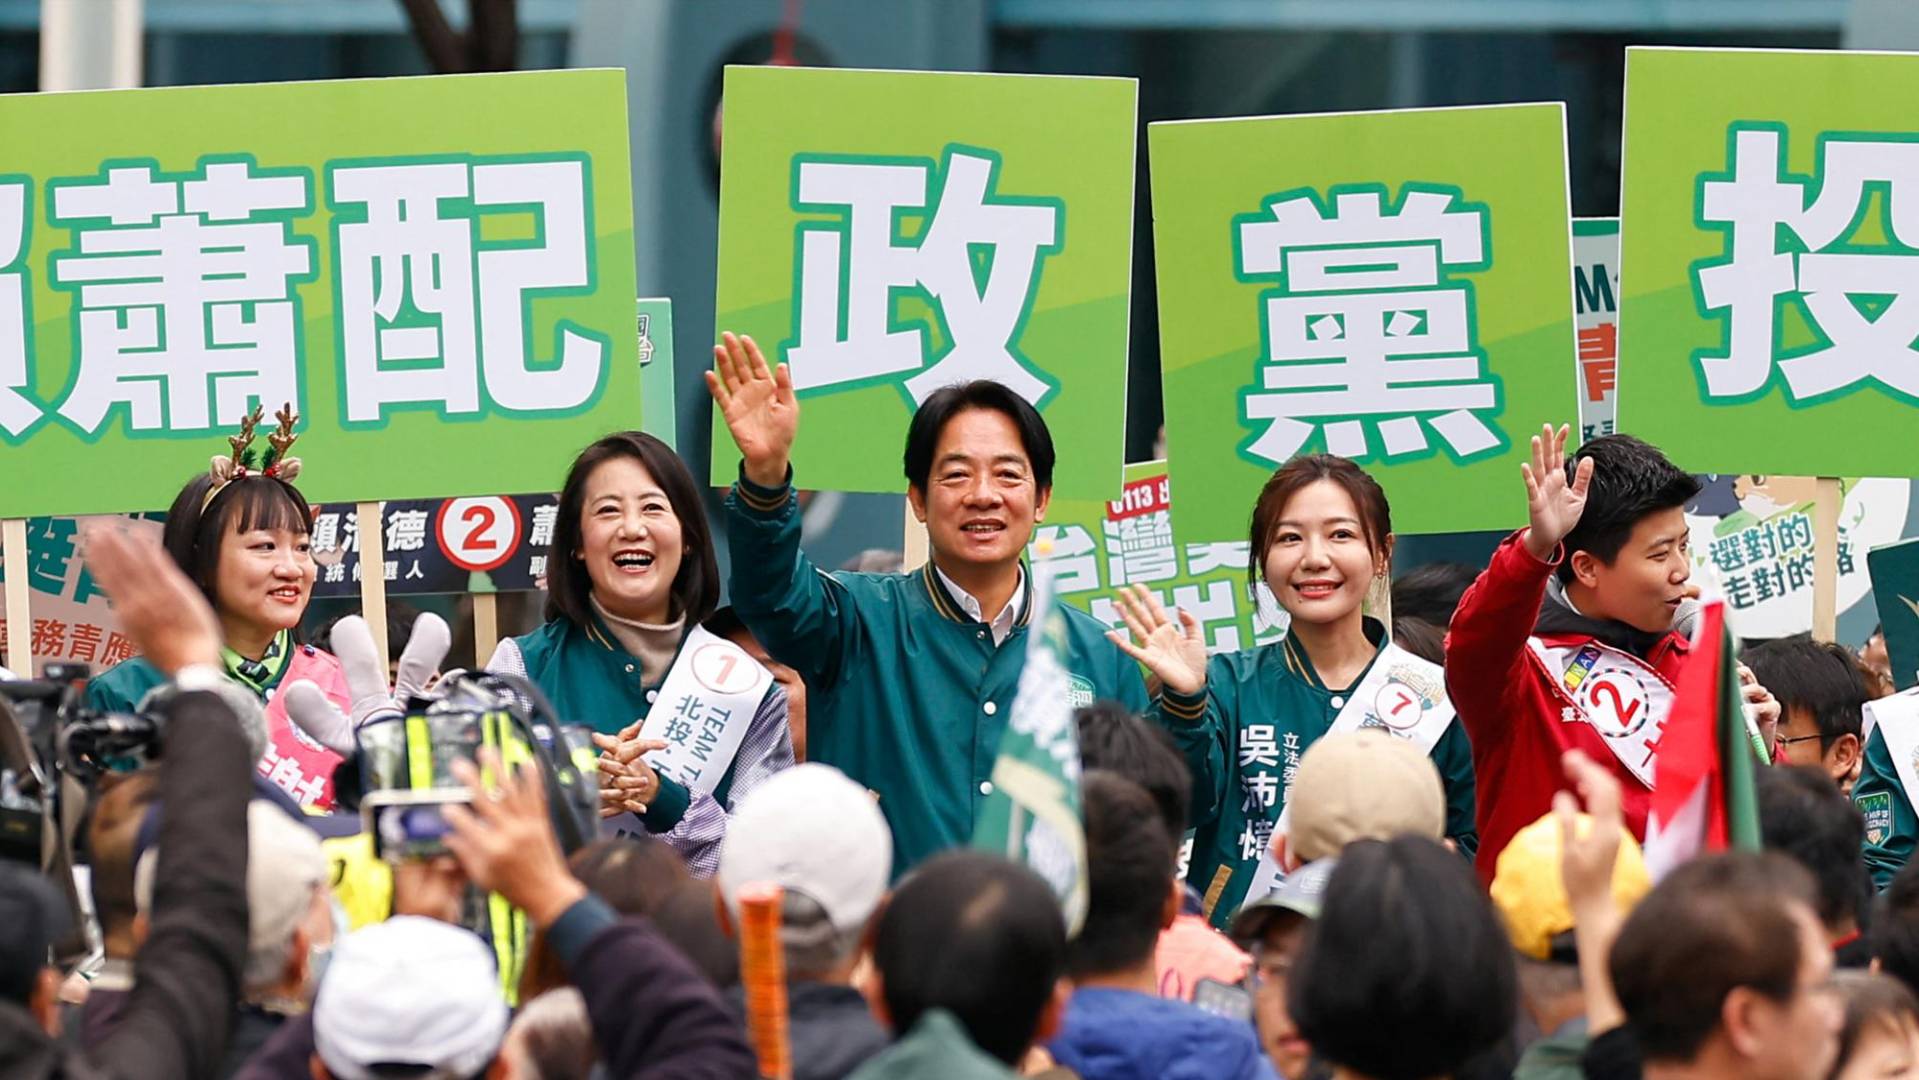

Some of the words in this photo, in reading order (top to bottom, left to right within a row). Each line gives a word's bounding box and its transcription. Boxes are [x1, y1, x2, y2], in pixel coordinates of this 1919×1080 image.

[0, 161, 602, 437] 蕭配
[787, 151, 1057, 404] 政
[1698, 129, 1919, 400] 投
[1239, 190, 1502, 463] 黨
[461, 505, 497, 550] 2
[714, 654, 738, 685] 1
[1390, 691, 1413, 717] 7
[1590, 680, 1641, 728] 2
[690, 706, 732, 763] TEAM
[1238, 724, 1281, 862] 吳沛憶
